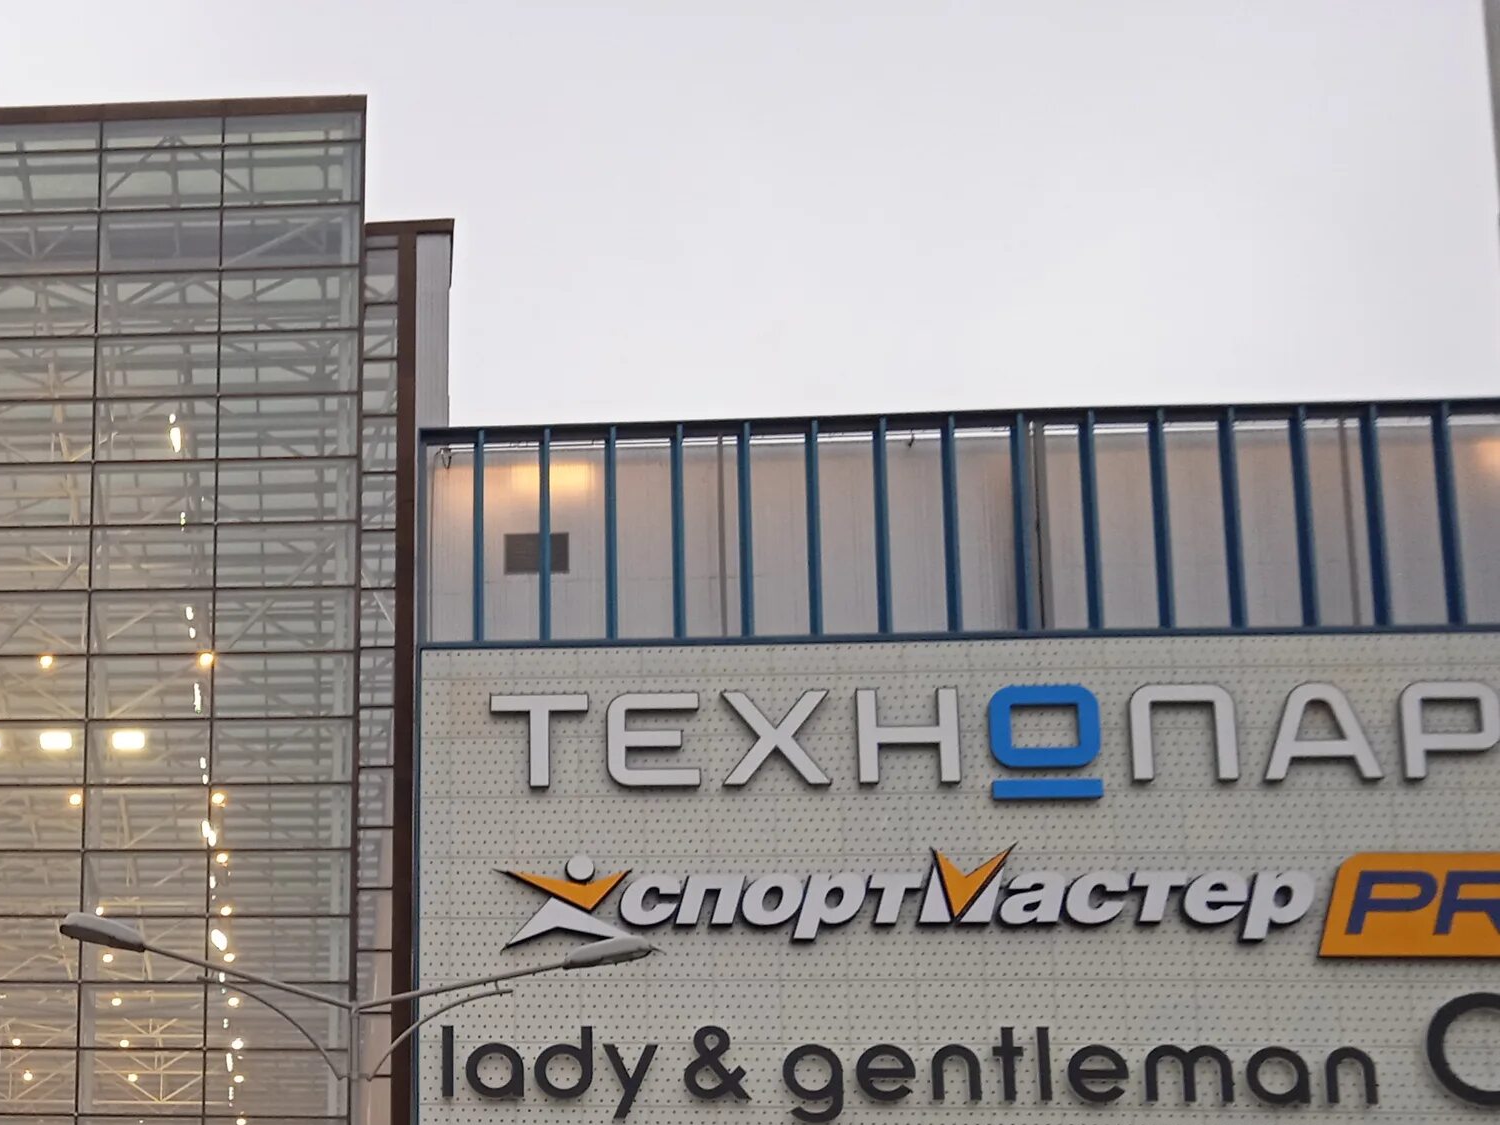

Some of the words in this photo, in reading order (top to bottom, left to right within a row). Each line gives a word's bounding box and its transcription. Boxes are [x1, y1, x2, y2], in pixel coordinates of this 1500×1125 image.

[441, 1024, 658, 1120] lady
[683, 1024, 752, 1102] &
[781, 1025, 1379, 1123] gentleman
